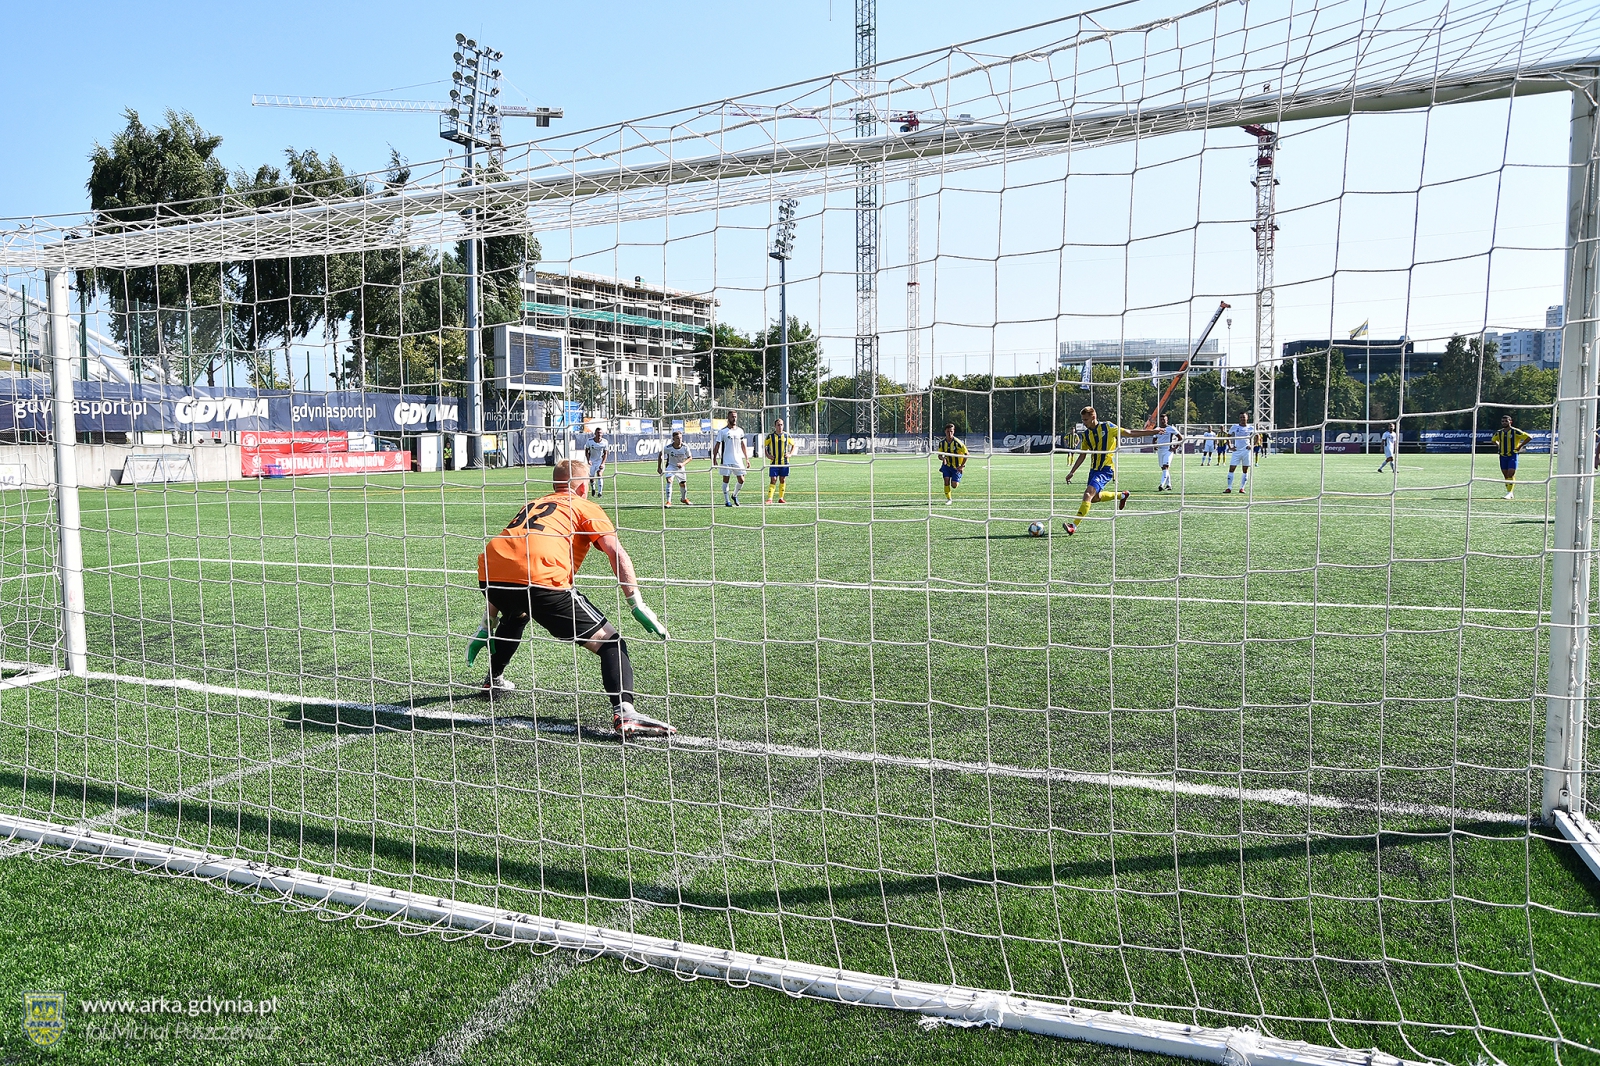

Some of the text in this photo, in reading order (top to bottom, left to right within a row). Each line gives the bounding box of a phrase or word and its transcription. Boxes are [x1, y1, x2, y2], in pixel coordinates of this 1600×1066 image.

[15, 394, 147, 419] gdyasport.pl
[175, 396, 269, 424] GDYNIA
[292, 402, 376, 423] gdyniasport.pl
[393, 402, 459, 425] GDYNIA
[275, 457, 324, 470] CENTRALNA
[345, 453, 386, 468] JUNIORÓW
